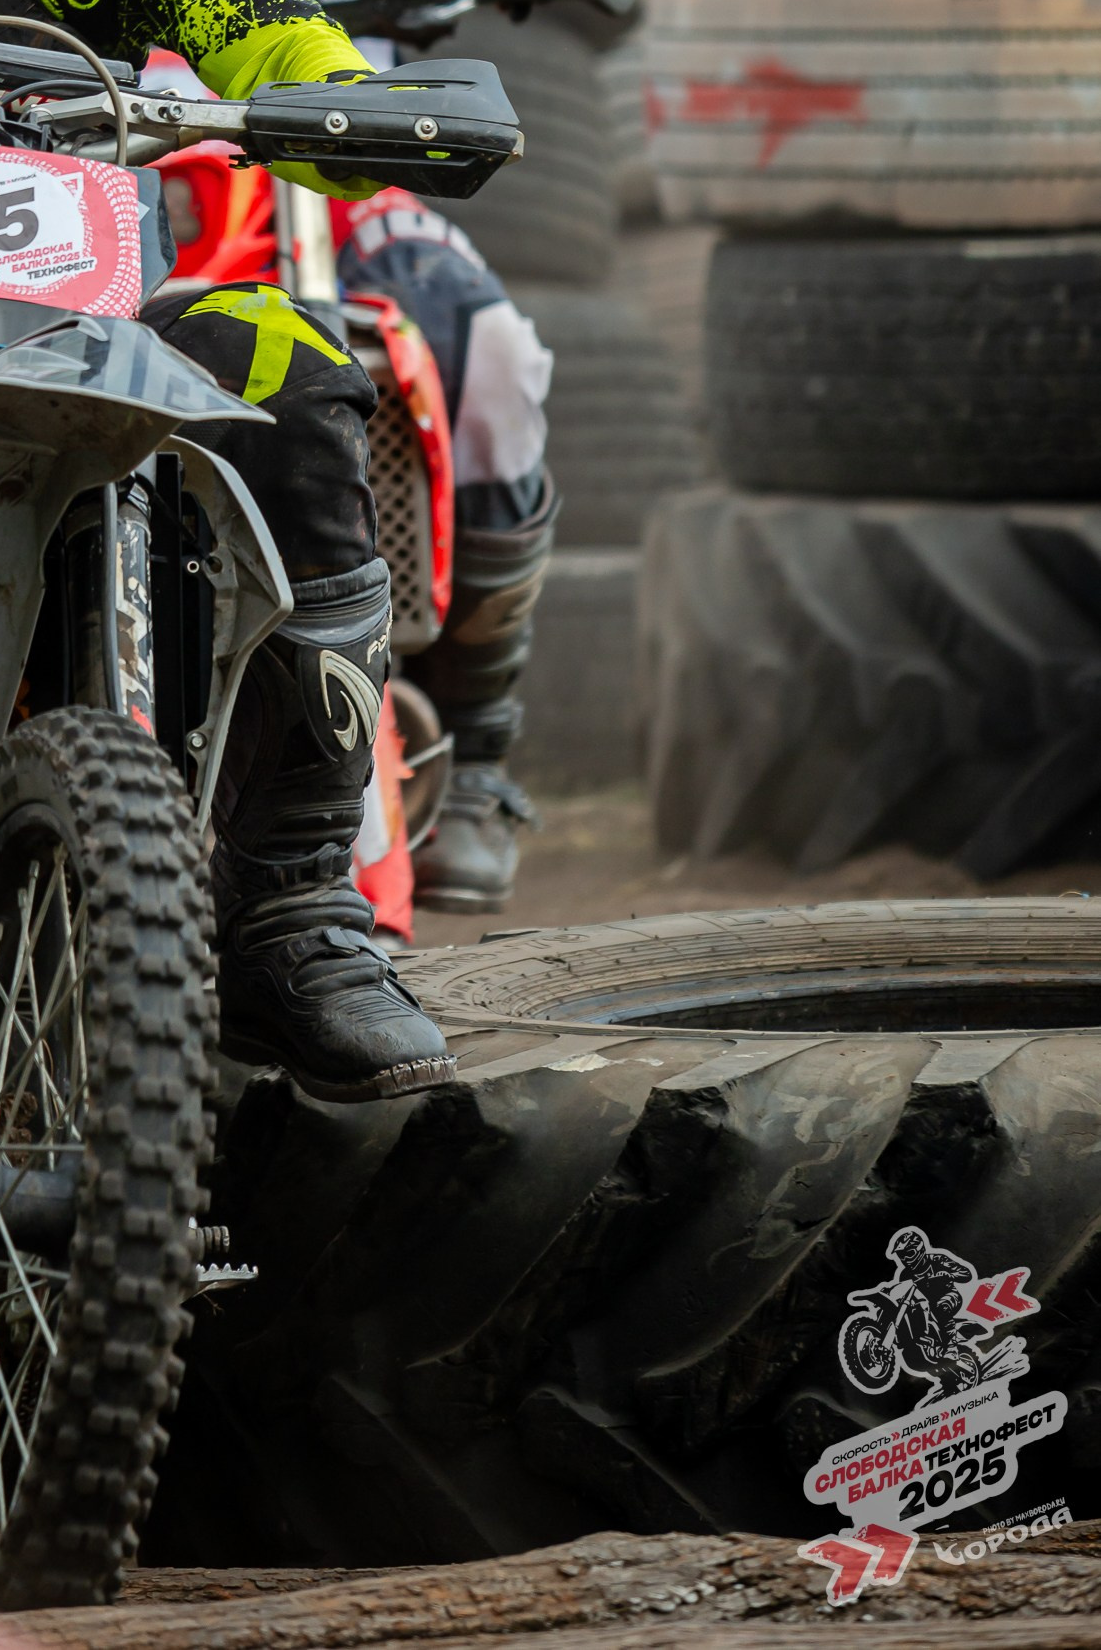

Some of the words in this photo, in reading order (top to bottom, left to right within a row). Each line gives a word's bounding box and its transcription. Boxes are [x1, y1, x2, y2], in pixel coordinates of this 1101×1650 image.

[12, 258, 51, 273] БАЛКА
[53, 252, 80, 264] 2025
[27, 260, 94, 280] ТЕХНОФЕСТ
